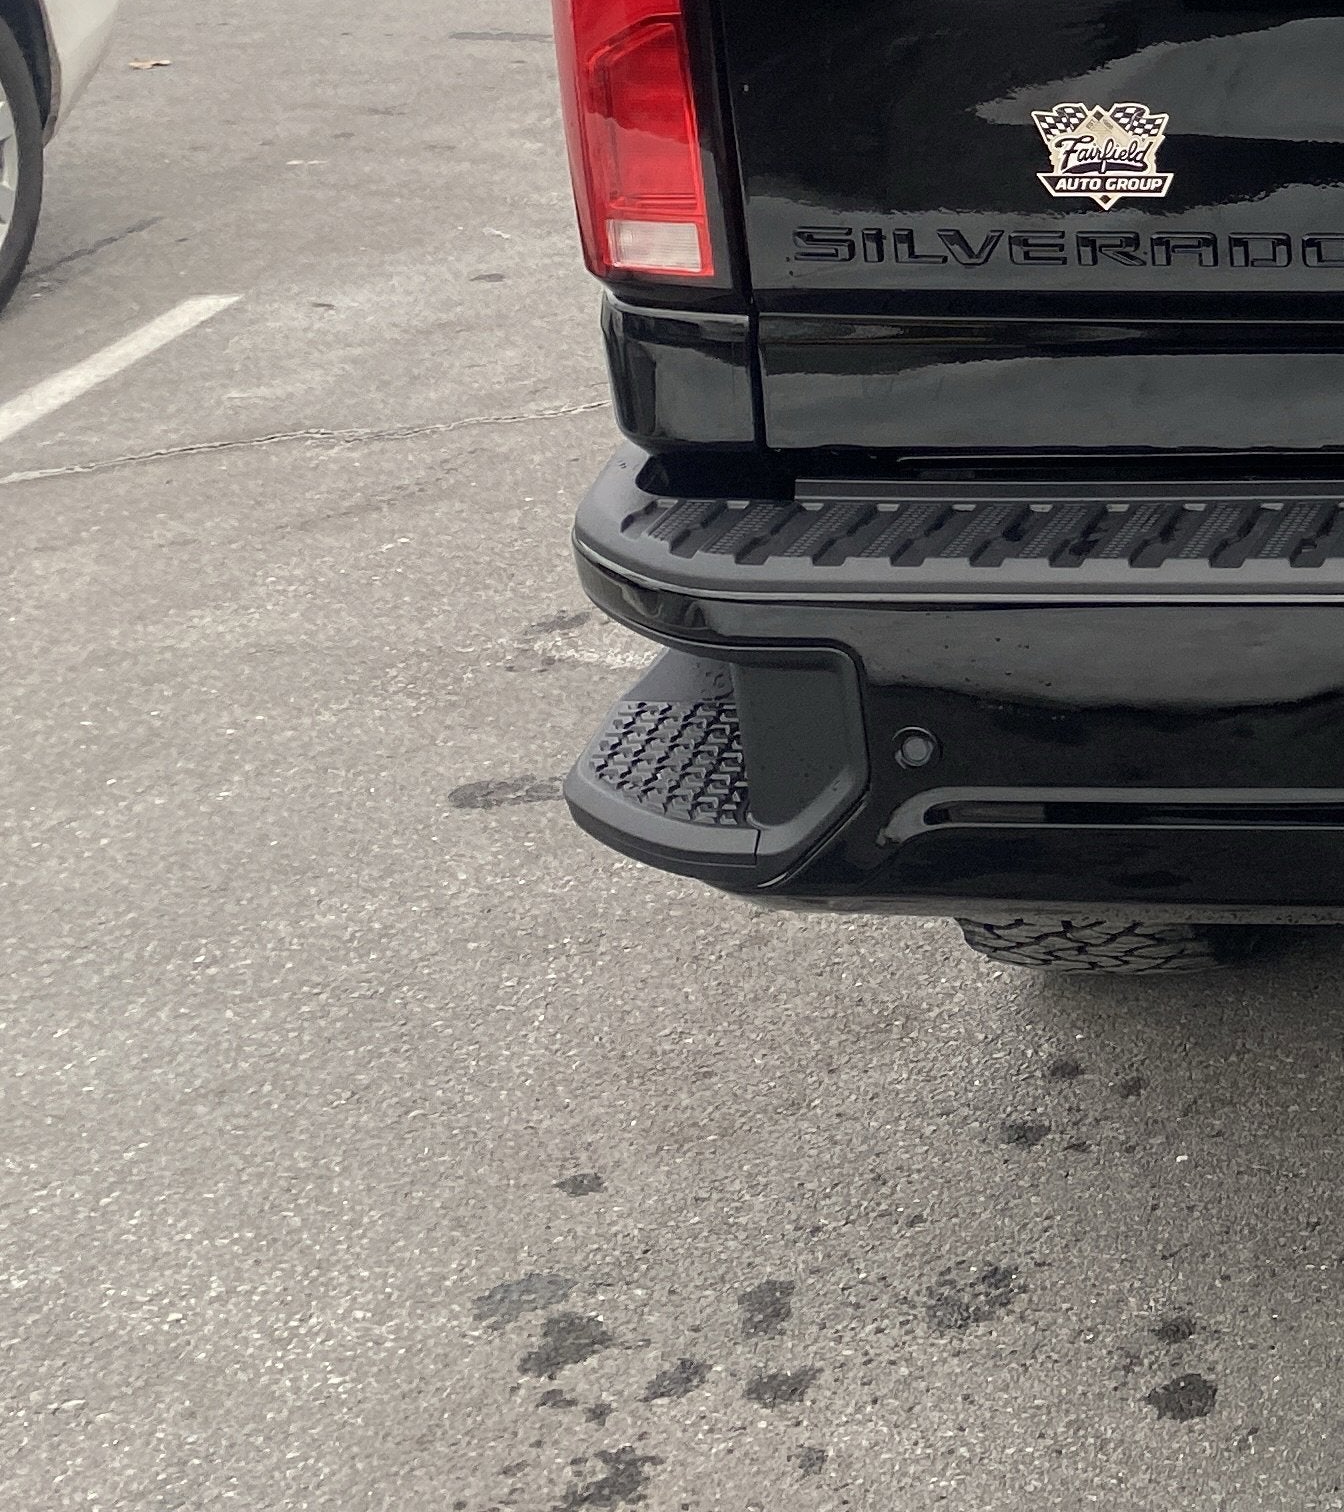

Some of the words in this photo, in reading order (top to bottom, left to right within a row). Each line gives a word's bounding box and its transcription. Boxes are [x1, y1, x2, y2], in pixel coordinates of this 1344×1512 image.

[1054, 135, 1154, 174] Fairfield
[1055, 178, 1100, 191] AUTO
[1105, 178, 1162, 191] GROUP
